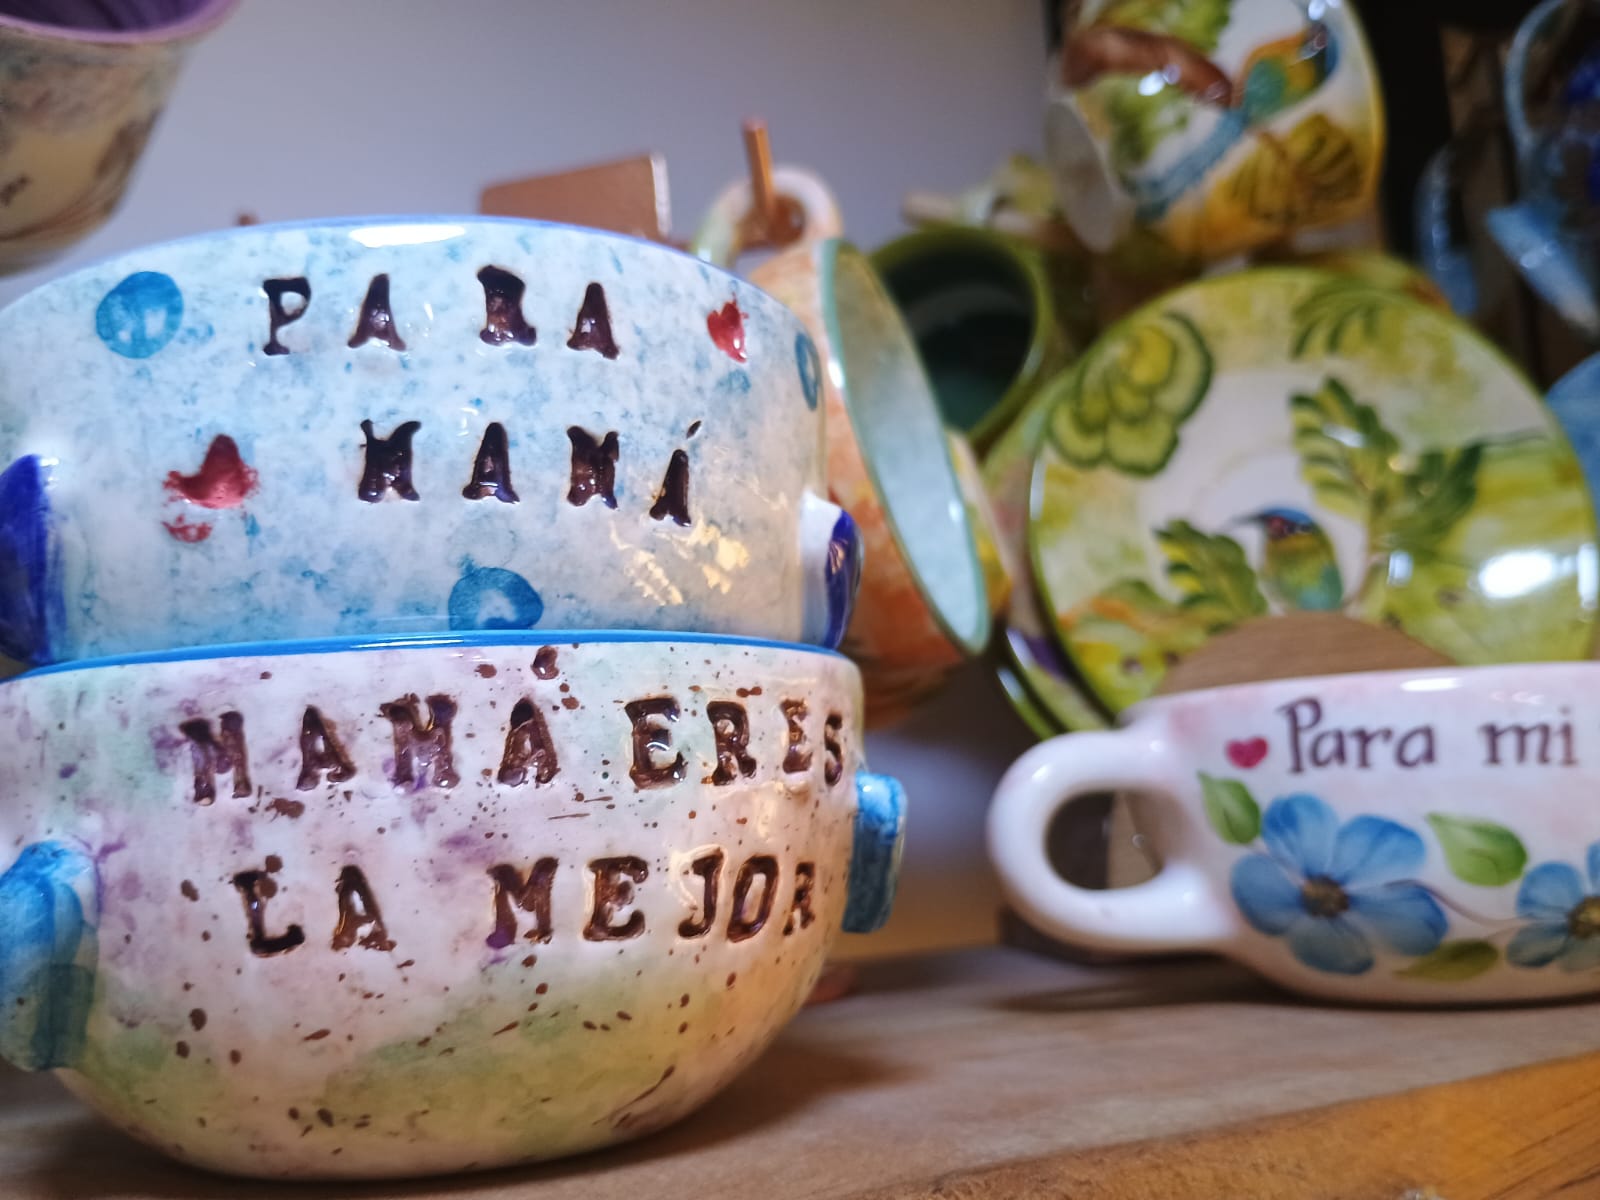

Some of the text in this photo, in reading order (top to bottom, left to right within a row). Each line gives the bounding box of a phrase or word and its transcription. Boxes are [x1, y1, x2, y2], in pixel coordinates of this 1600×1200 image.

[262, 264, 620, 360] PARA
[357, 419, 702, 527] MAMÁ
[624, 697, 844, 787] ERES
[1275, 697, 1580, 775] Para mi
[232, 846, 817, 957] LA MEJOR
